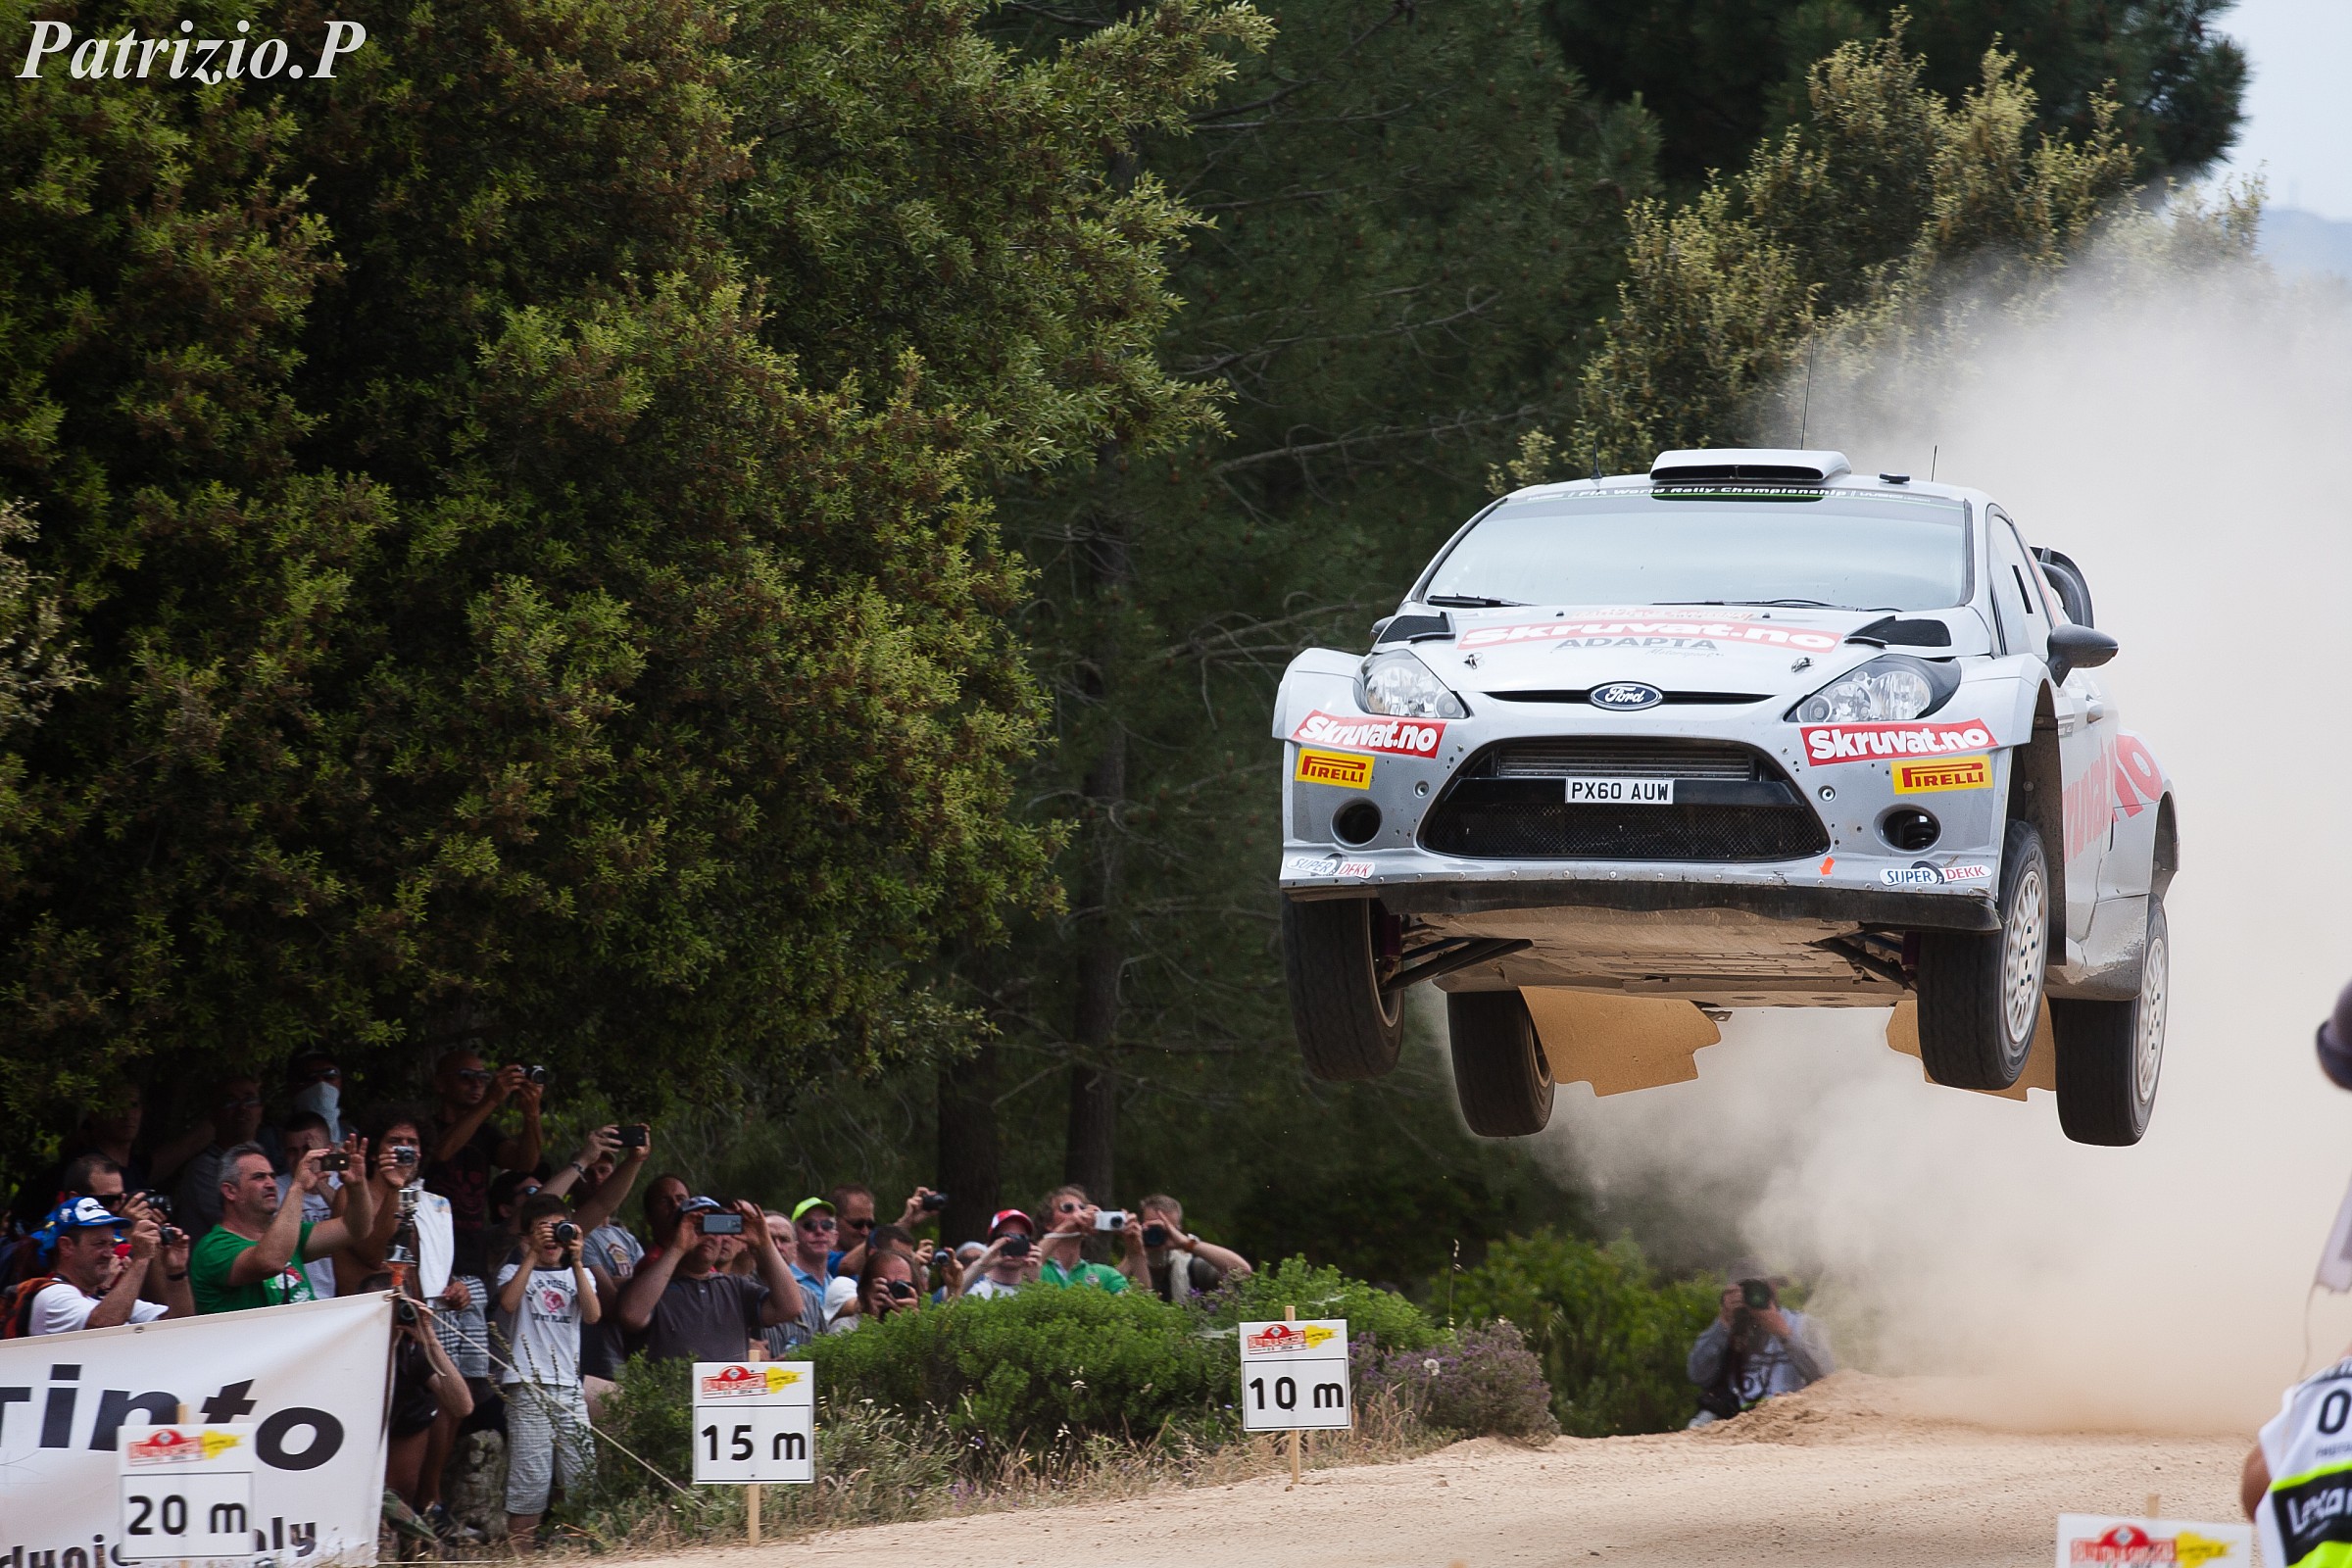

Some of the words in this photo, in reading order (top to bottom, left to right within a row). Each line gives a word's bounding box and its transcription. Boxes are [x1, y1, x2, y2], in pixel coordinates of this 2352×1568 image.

[1720, 487, 1846, 497] Championship
[1554, 637, 1718, 650] ADAPTA
[1604, 686, 1646, 703] Ford
[1298, 715, 1438, 752] Skruvat.no
[1808, 727, 1989, 760] Skruvat.no
[1301, 755, 1367, 783] PIRELLI
[1901, 761, 1984, 788] PIRELLI
[1571, 782, 1622, 800] PX60
[1631, 783, 1669, 801] AUW
[1293, 858, 1333, 873] SUPER
[1339, 863, 1372, 877] DEKK
[1886, 870, 1933, 883] SUPER
[1945, 866, 1985, 880] DEKK
[1249, 1376, 1297, 1410] 10
[1313, 1383, 1344, 1408] m
[701, 1424, 754, 1461] 15
[772, 1432, 806, 1460] m
[128, 1494, 188, 1536] 20
[210, 1502, 248, 1534] m
